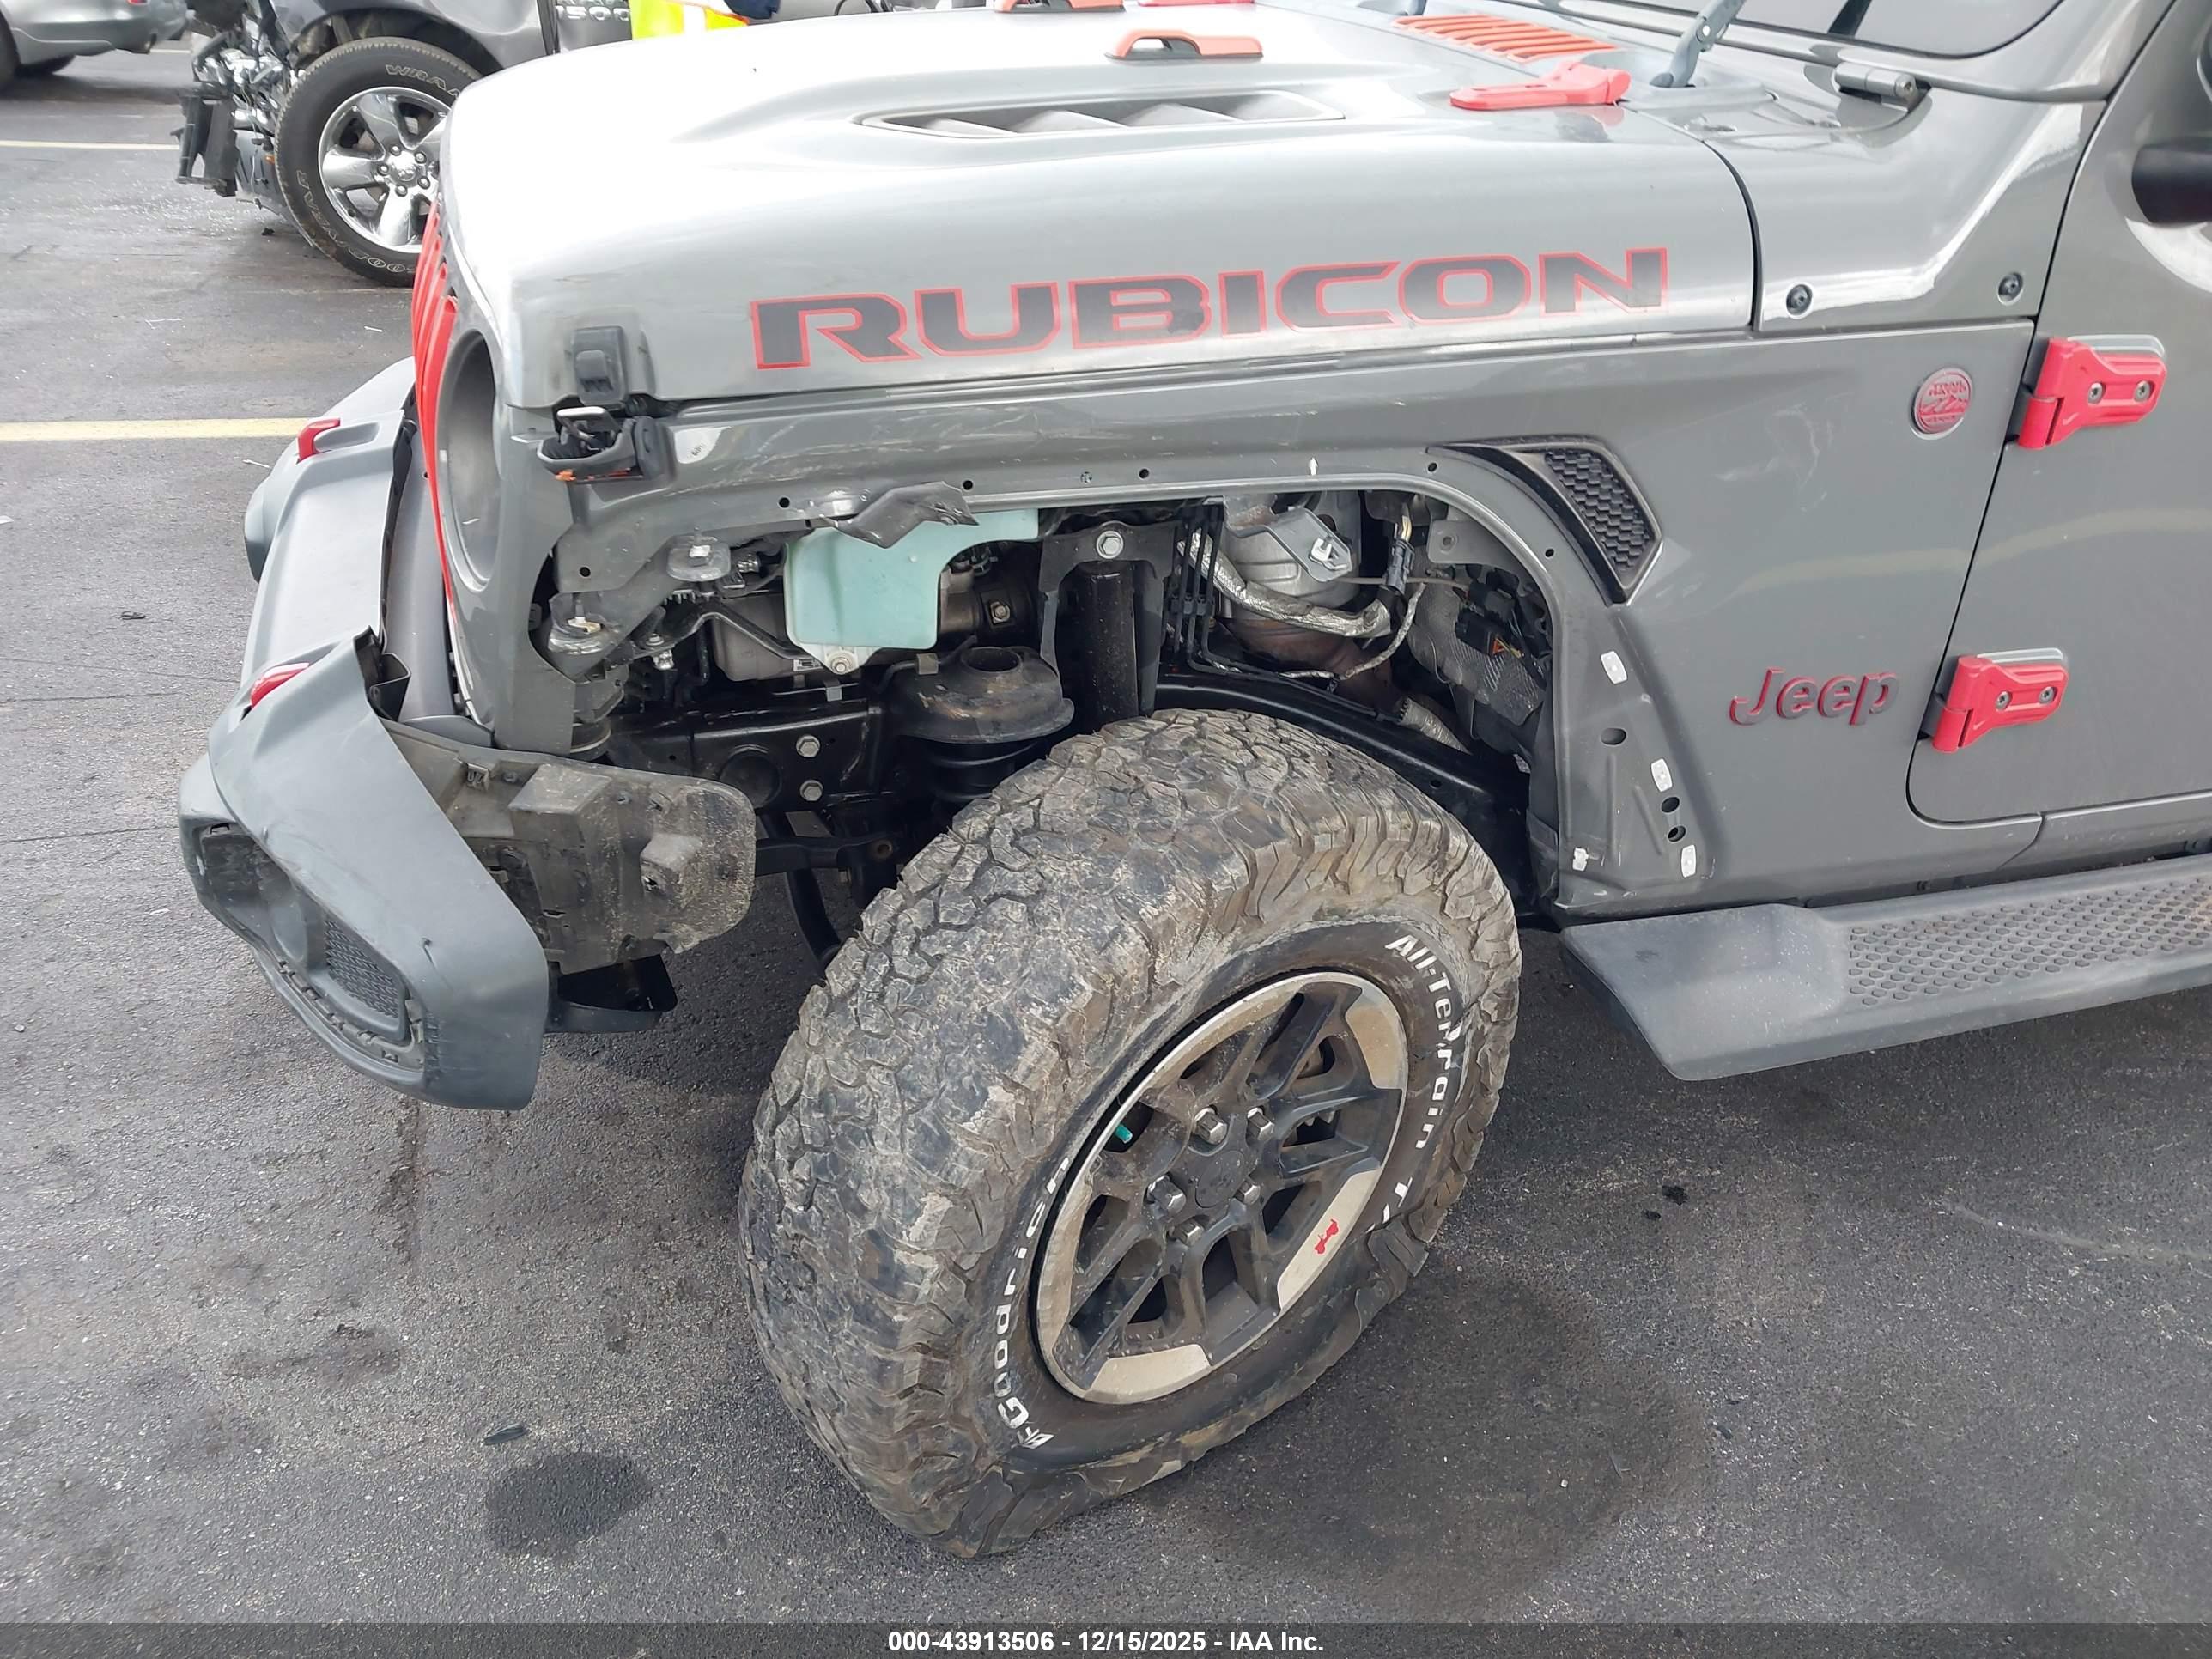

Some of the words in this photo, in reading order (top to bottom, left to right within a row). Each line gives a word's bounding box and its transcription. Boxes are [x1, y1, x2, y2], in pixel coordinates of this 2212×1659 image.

[750, 246, 1668, 370] RUBICON
[1729, 666, 1899, 726] Jeep
[1384, 934, 1463, 1149] All-Terrain
